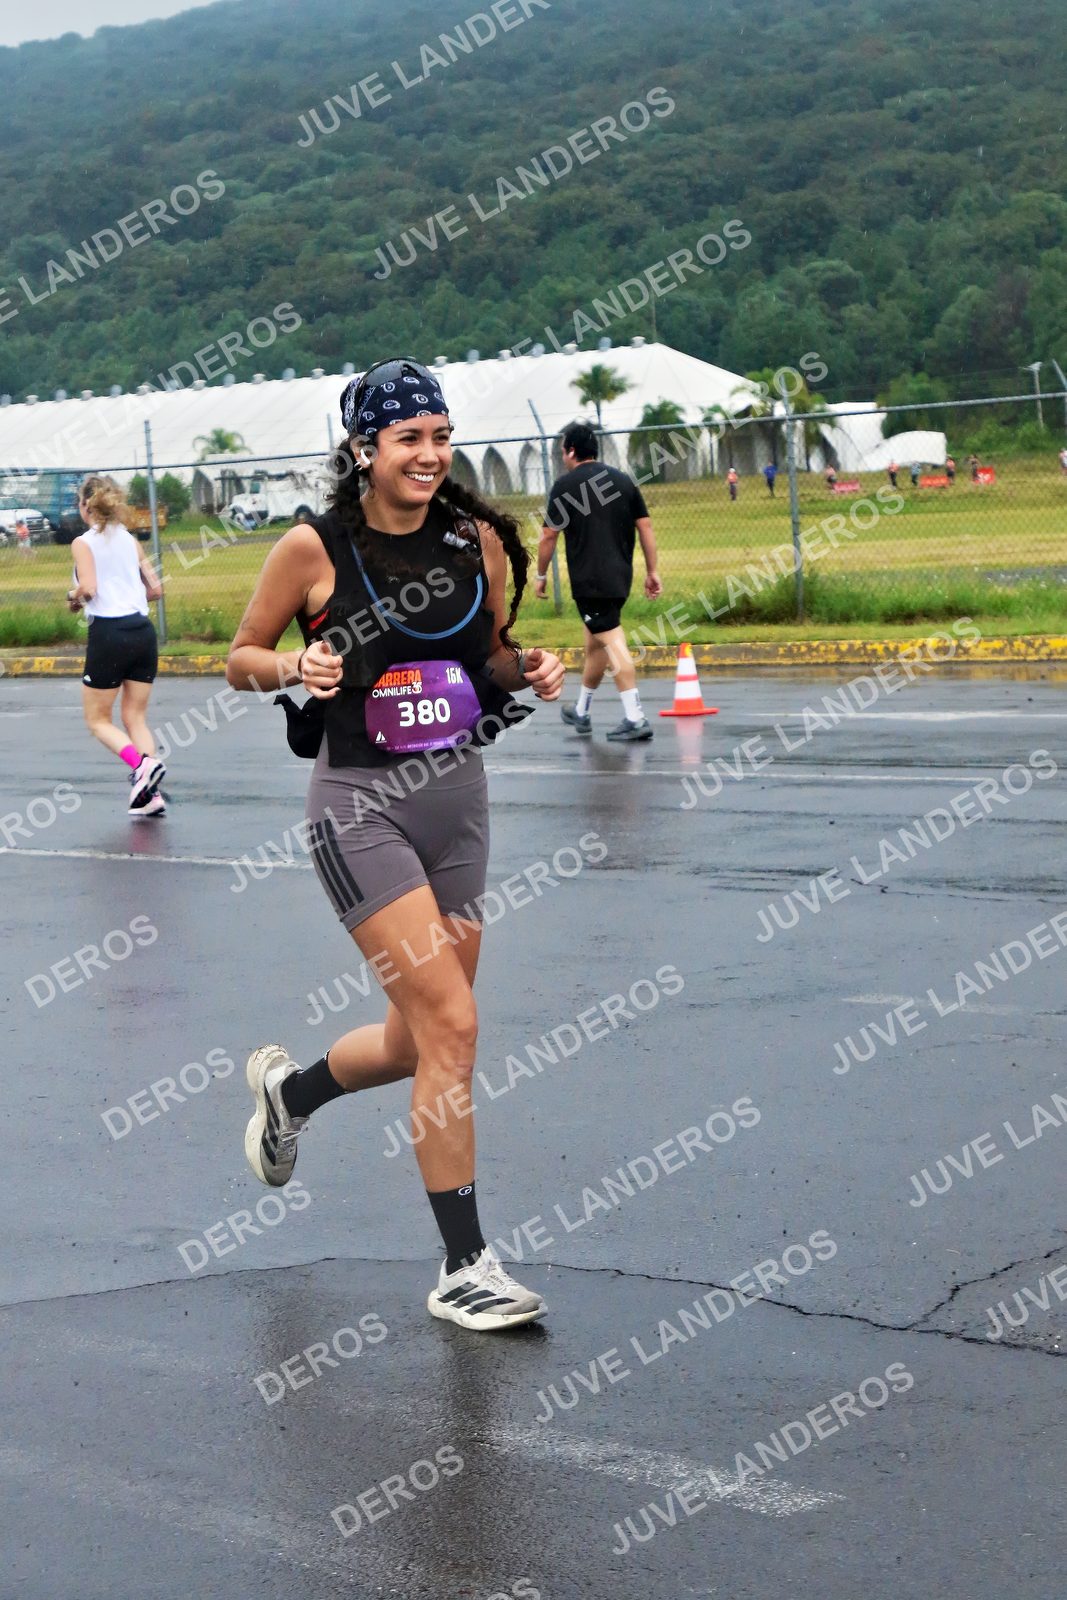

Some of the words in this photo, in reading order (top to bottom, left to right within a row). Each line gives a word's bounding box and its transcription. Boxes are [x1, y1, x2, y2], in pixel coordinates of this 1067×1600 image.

[373, 669, 422, 688] ARRERA
[372, 685, 412, 699] OMNILIFE
[397, 697, 451, 727] 380
